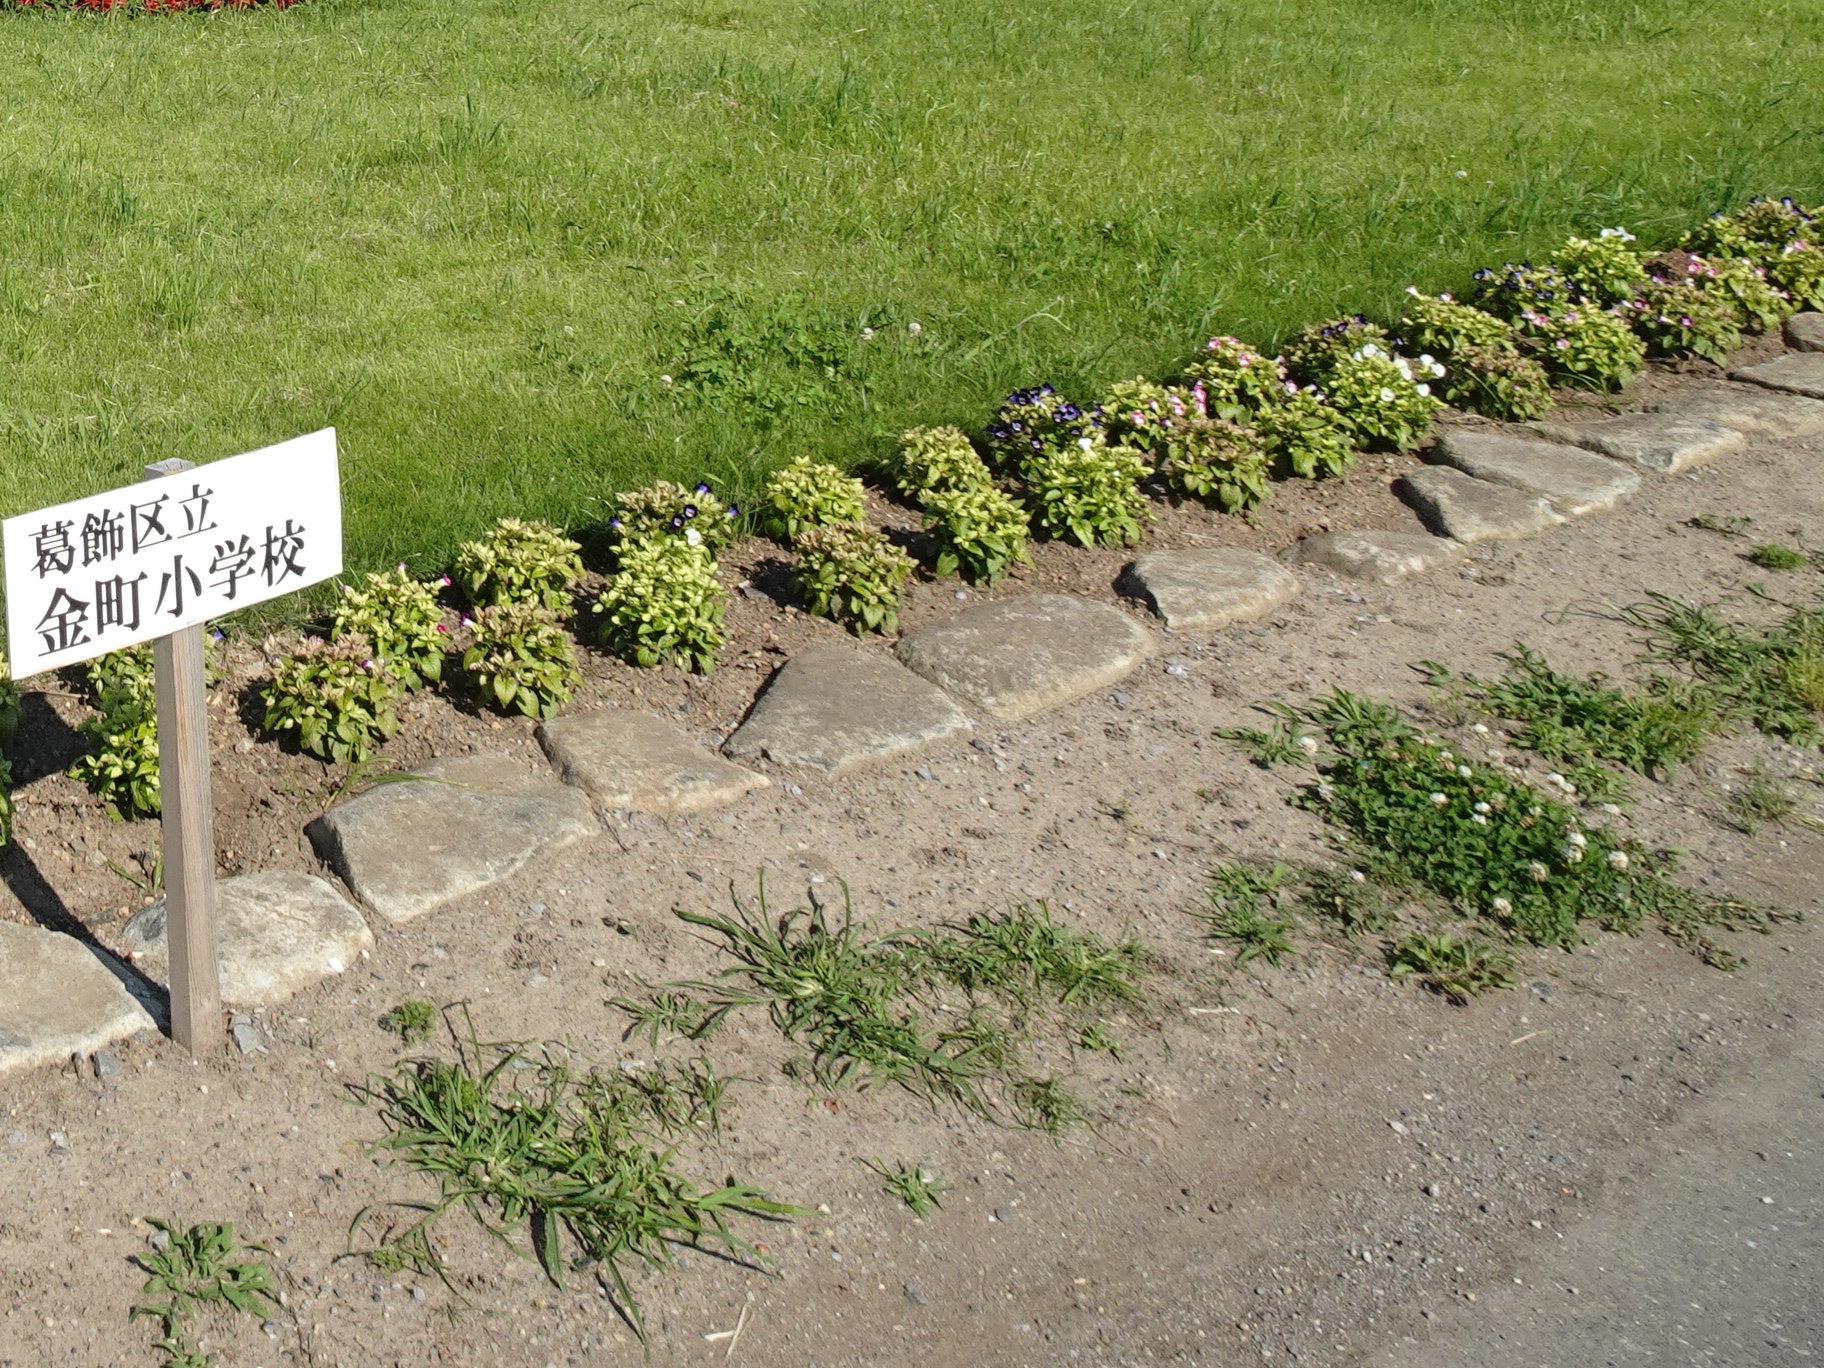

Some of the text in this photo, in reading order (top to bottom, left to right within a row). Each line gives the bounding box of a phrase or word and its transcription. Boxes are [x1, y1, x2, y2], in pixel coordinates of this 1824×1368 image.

[28, 484, 218, 579] 葛飾区立
[35, 519, 306, 657] 金町小学校
